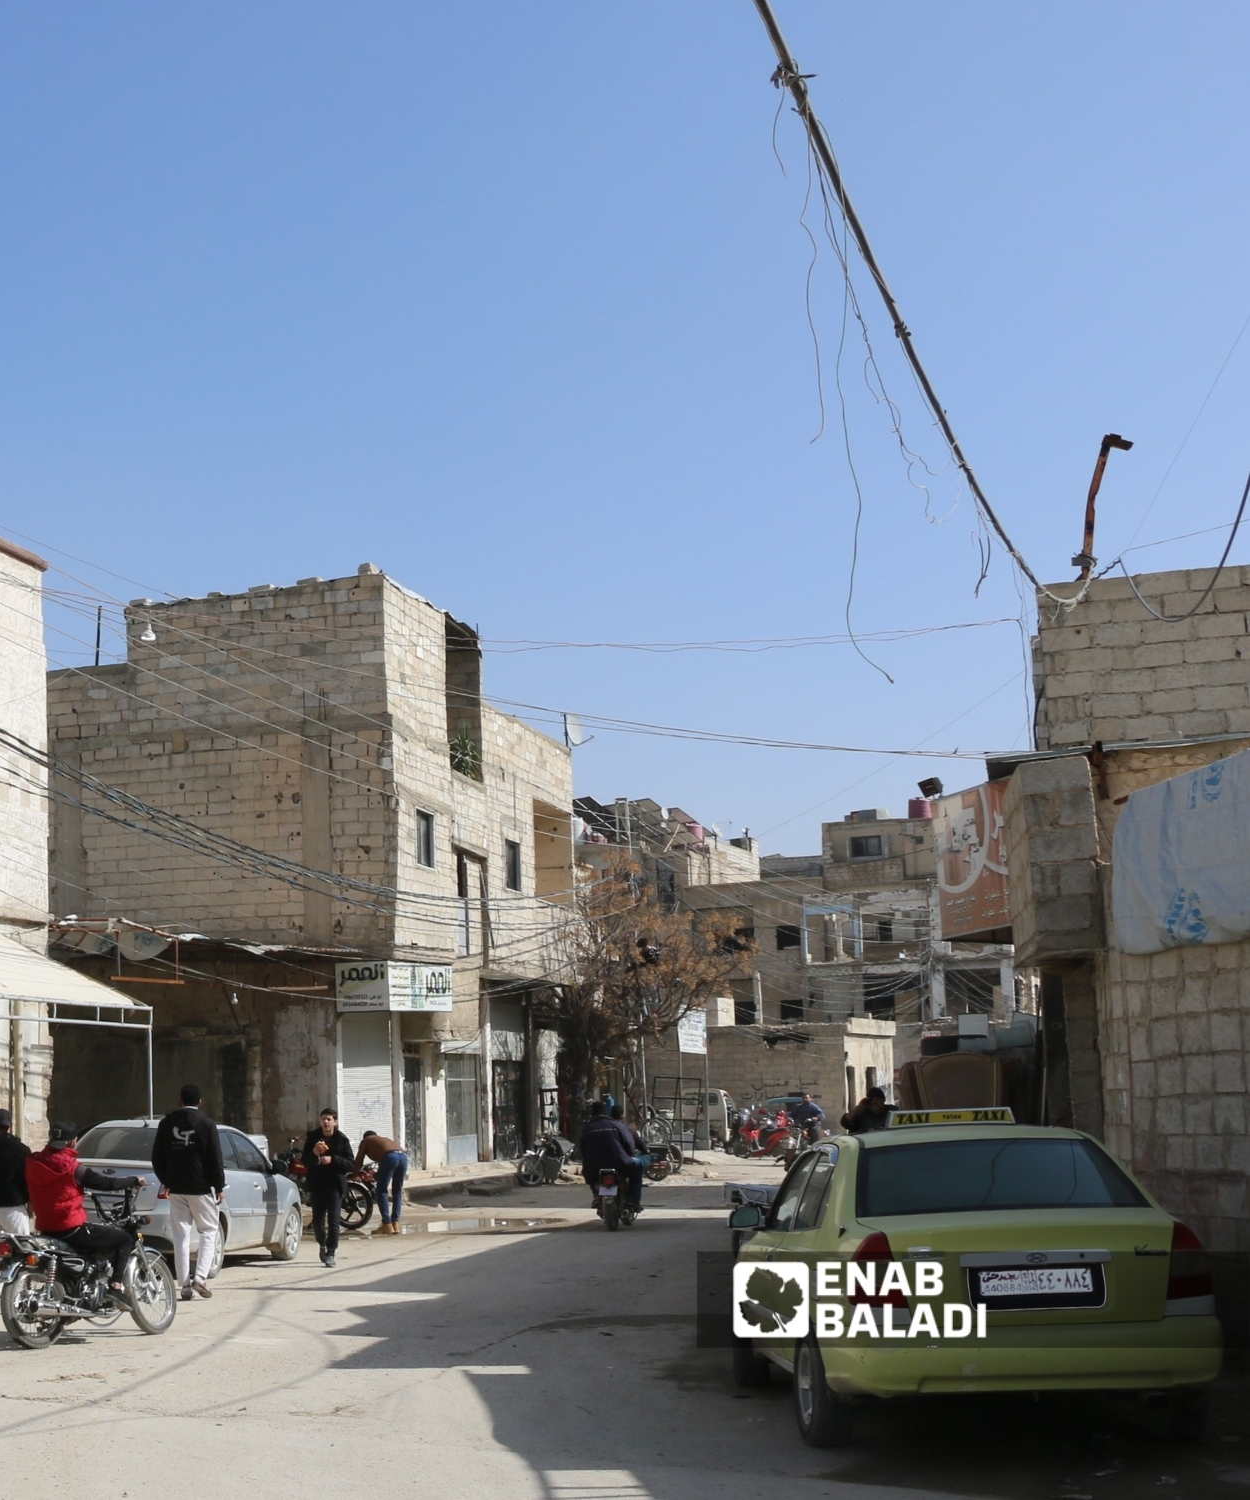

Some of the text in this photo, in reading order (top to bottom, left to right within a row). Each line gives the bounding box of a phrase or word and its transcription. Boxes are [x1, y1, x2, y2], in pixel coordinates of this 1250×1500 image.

[896, 1113, 931, 1125] TAXI
[971, 1110, 1007, 1121] TAXI
[1038, 1269, 1090, 1290] ٤٤٠٨٨٤
[983, 1283, 1022, 1293] 440884
